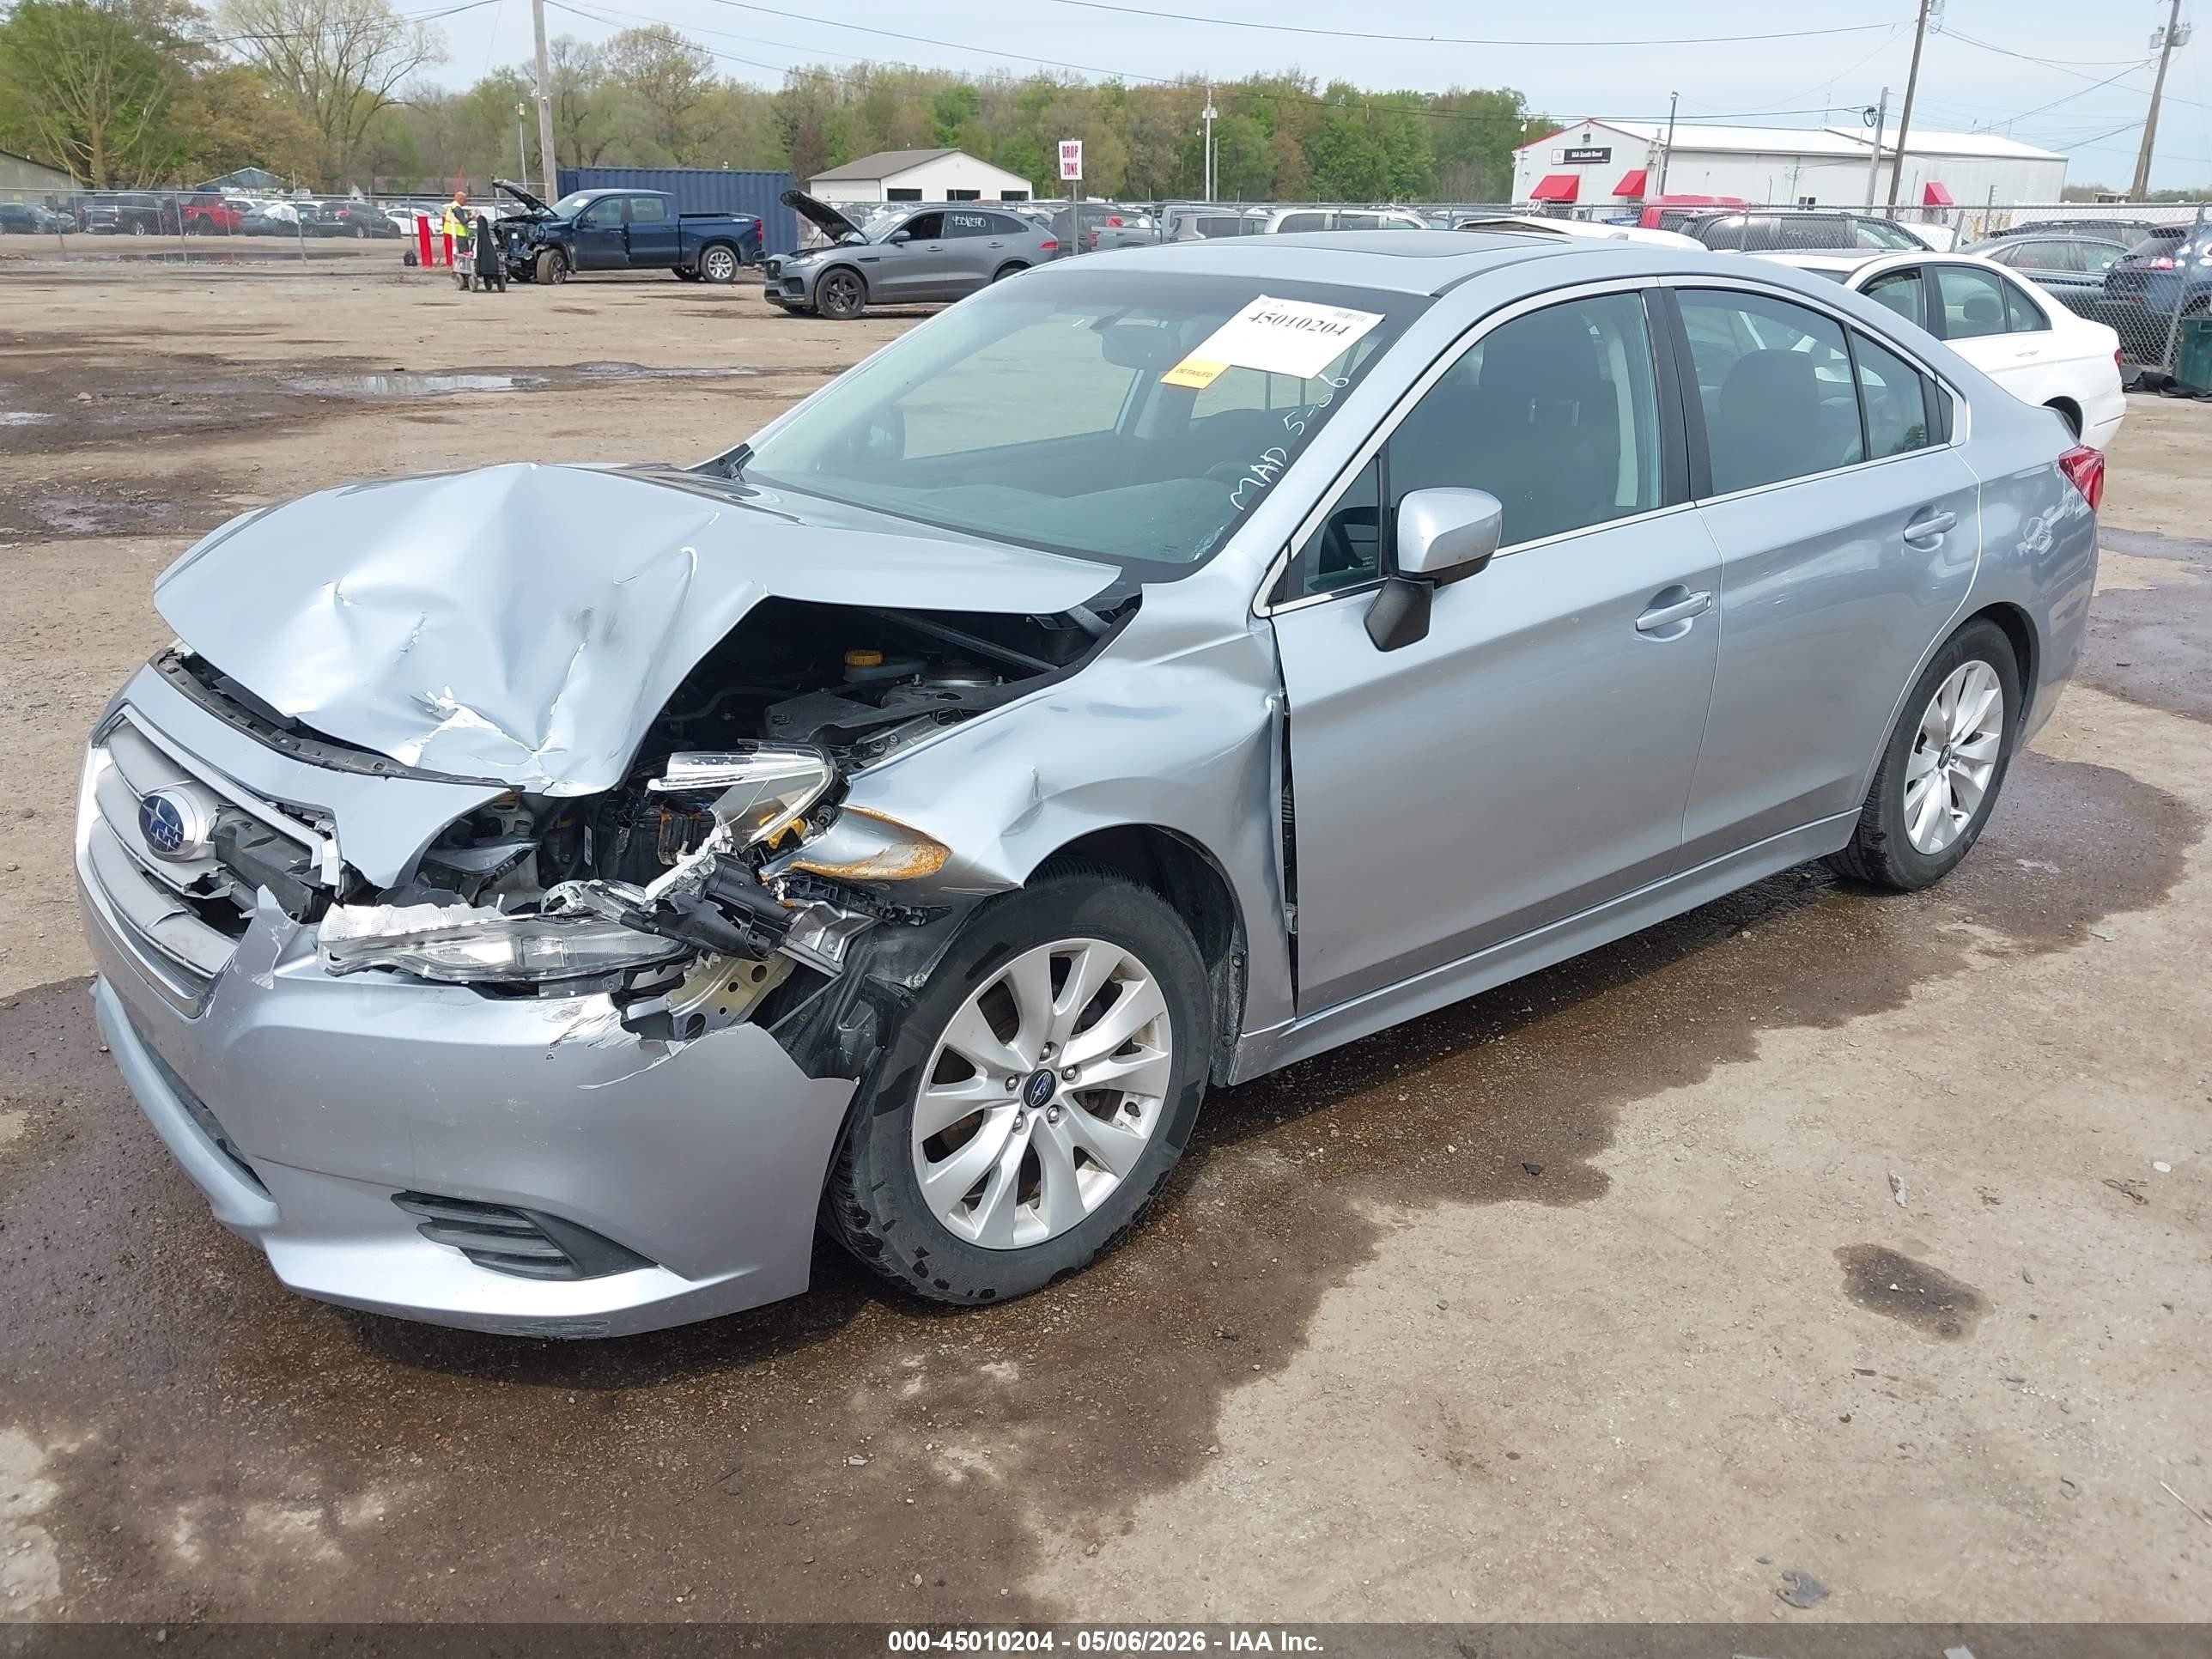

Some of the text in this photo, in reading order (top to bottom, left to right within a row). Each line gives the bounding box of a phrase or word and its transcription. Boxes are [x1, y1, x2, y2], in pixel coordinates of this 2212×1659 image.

[1062, 145, 1079, 158] DROP
[1064, 163, 1079, 175] ZONE
[1248, 310, 1352, 337] 45010204
[1175, 368, 1213, 379] DETAILED
[1229, 446, 1288, 511] MAD
